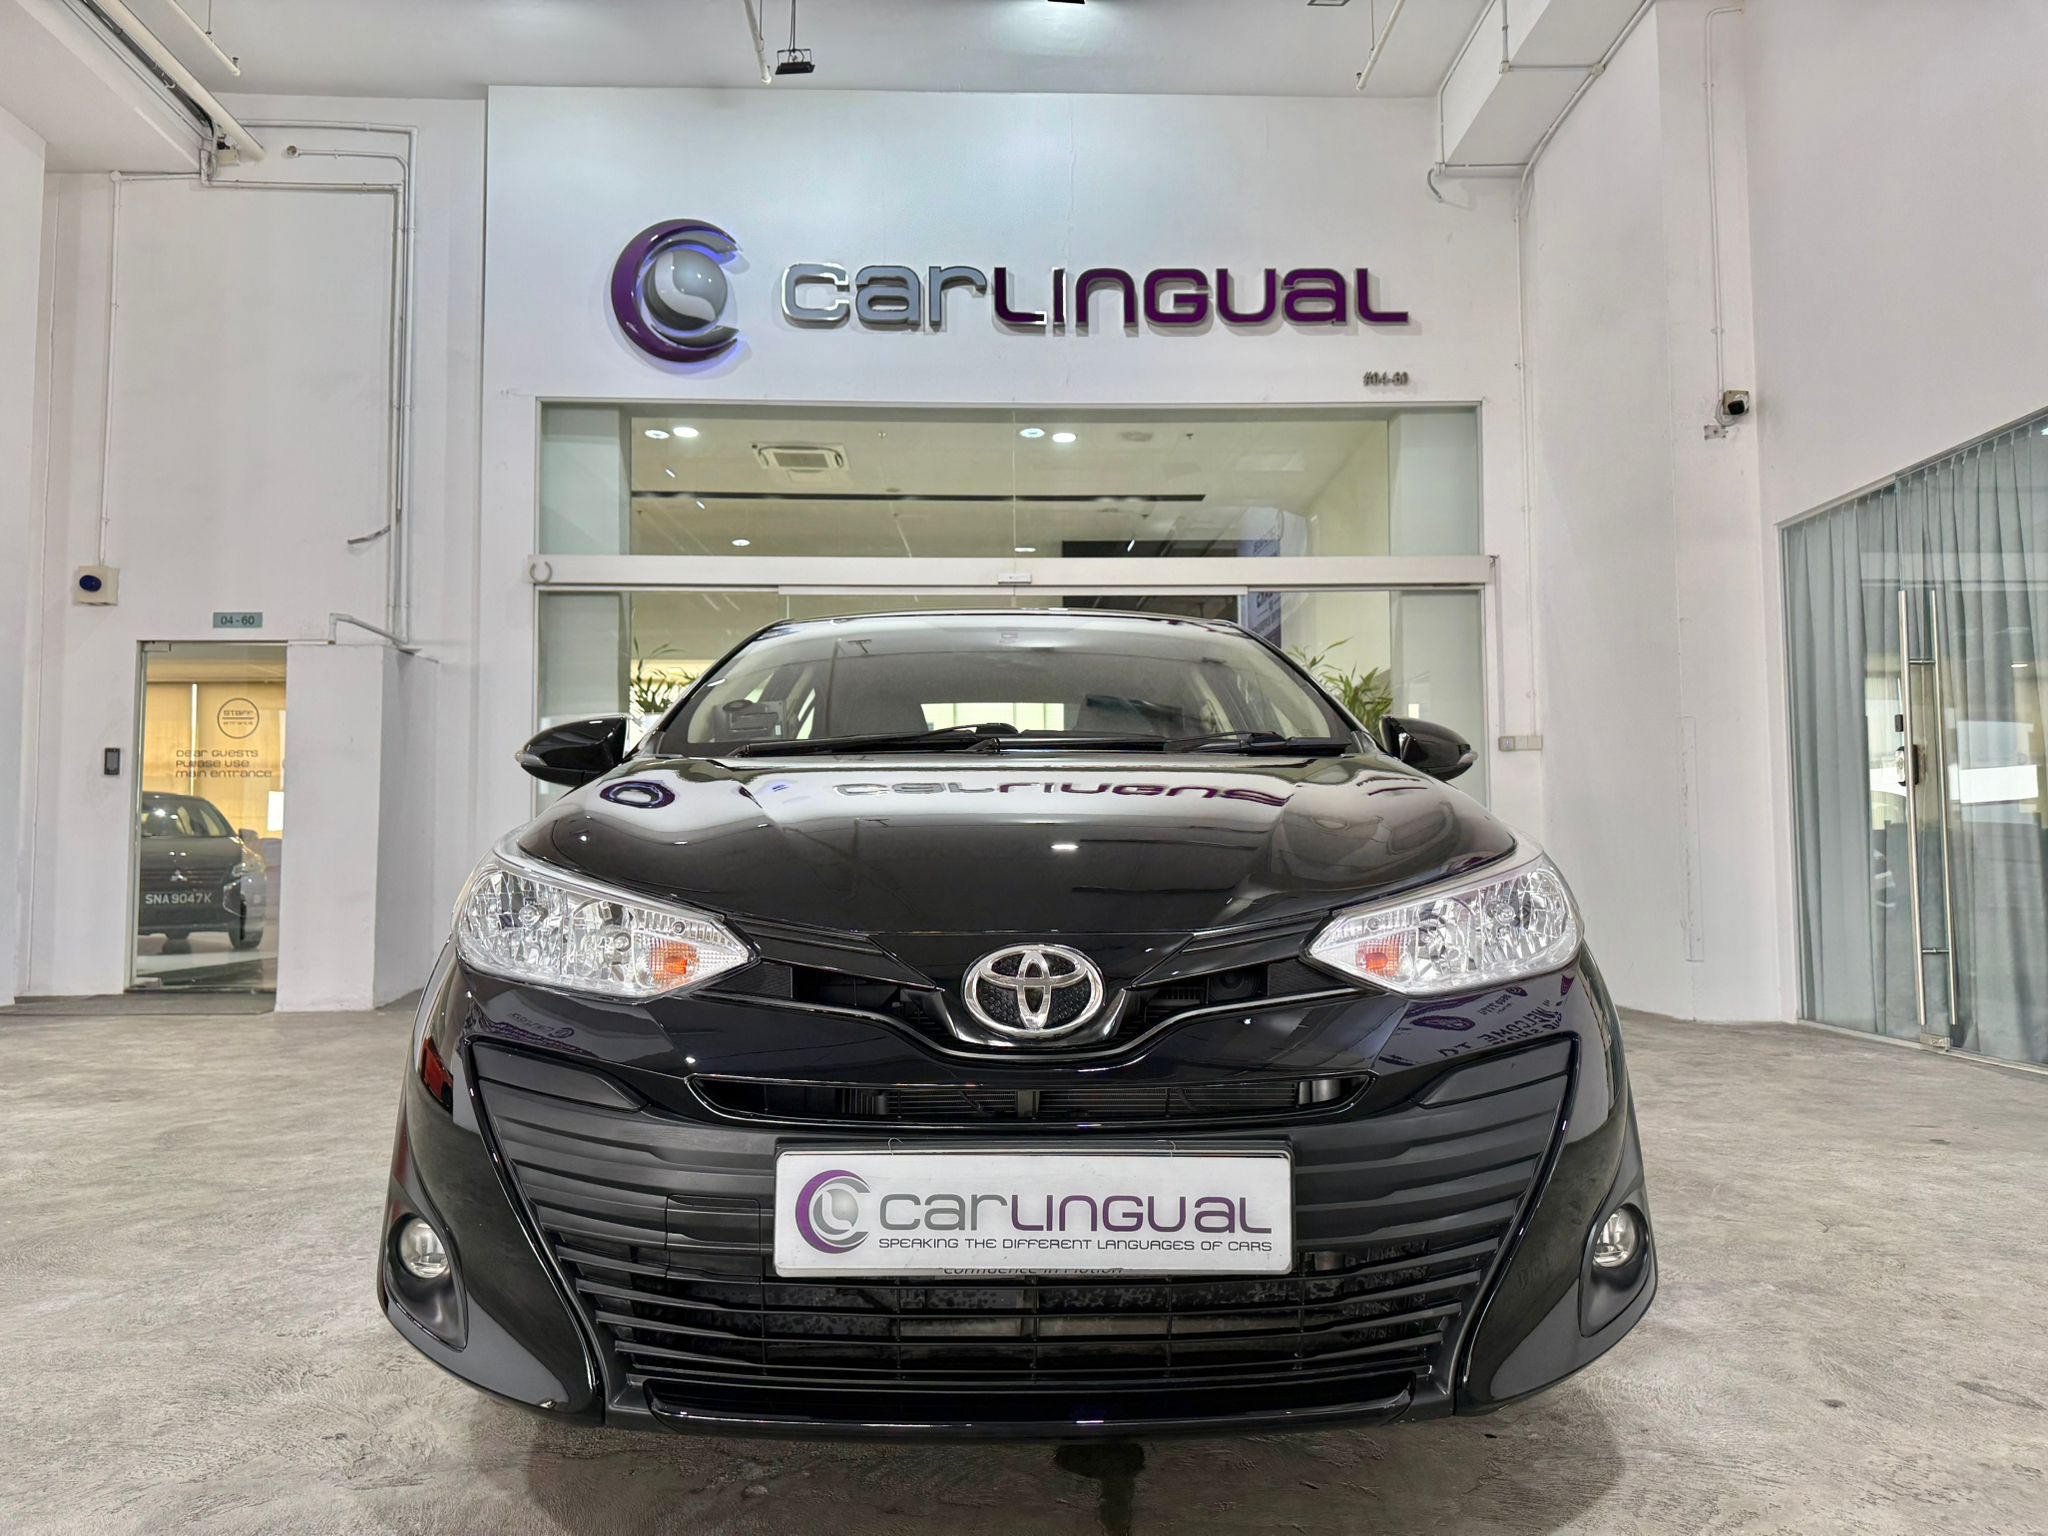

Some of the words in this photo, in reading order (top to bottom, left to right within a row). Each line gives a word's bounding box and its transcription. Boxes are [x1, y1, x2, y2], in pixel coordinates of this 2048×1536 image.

[878, 1238, 959, 1249] SPEAKING
[964, 1238, 997, 1249] THE
[1002, 1239, 1093, 1250] DIFFERENT
[1097, 1239, 1195, 1251] LANGUAGES
[1200, 1240, 1223, 1251] OF
[1228, 1240, 1272, 1252] CARS
